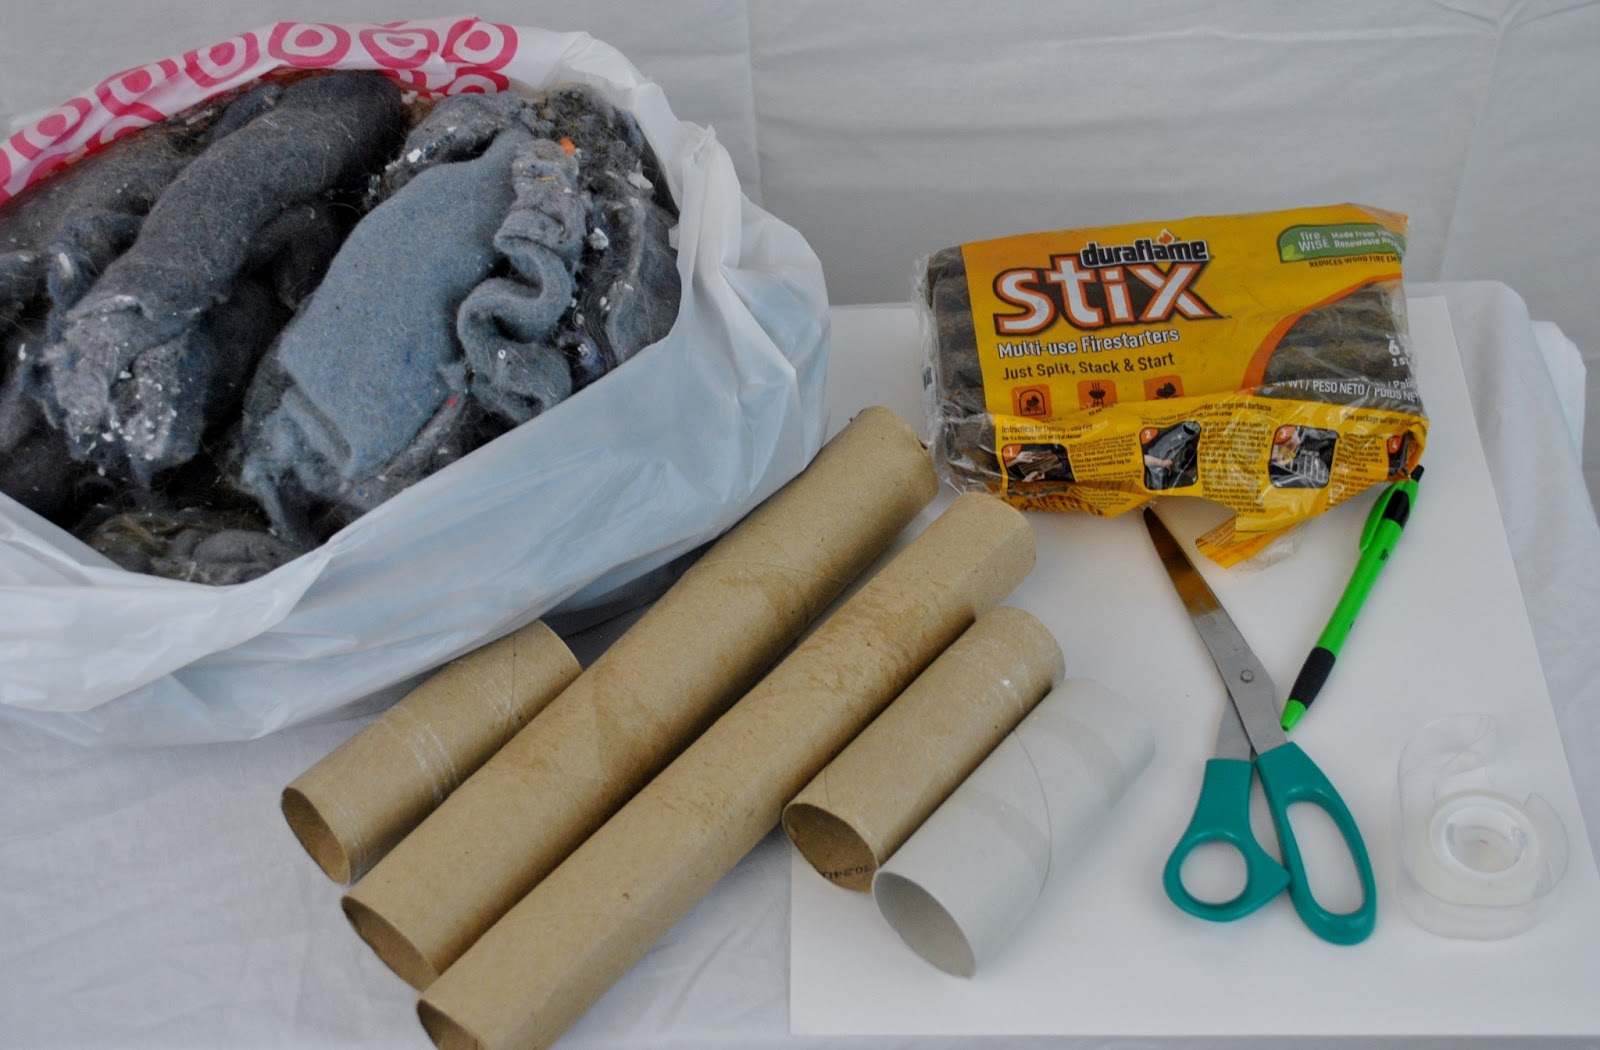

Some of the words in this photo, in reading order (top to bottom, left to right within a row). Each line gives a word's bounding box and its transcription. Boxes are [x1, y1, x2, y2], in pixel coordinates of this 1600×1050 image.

[1331, 231, 1354, 240] Made
[1298, 240, 1330, 252] WISE
[1334, 237, 1381, 249] Renewable
[1081, 239, 1209, 267] duraflame
[1308, 256, 1343, 268] REDUCES
[1345, 256, 1369, 265] WOOD
[997, 340, 1078, 359] Multi-use
[1080, 329, 1180, 353] Firestarters
[1003, 366, 1034, 381] Just
[1037, 363, 1076, 378] Split,
[1079, 360, 1120, 375] Stack
[1123, 358, 1135, 372] &
[1137, 352, 1176, 370] Start
[1312, 380, 1338, 394] PESO
[1339, 382, 1365, 396] NETO
[1280, 429, 1287, 439] 3
[1392, 440, 1398, 449] 4
[1008, 446, 1013, 457] 1
